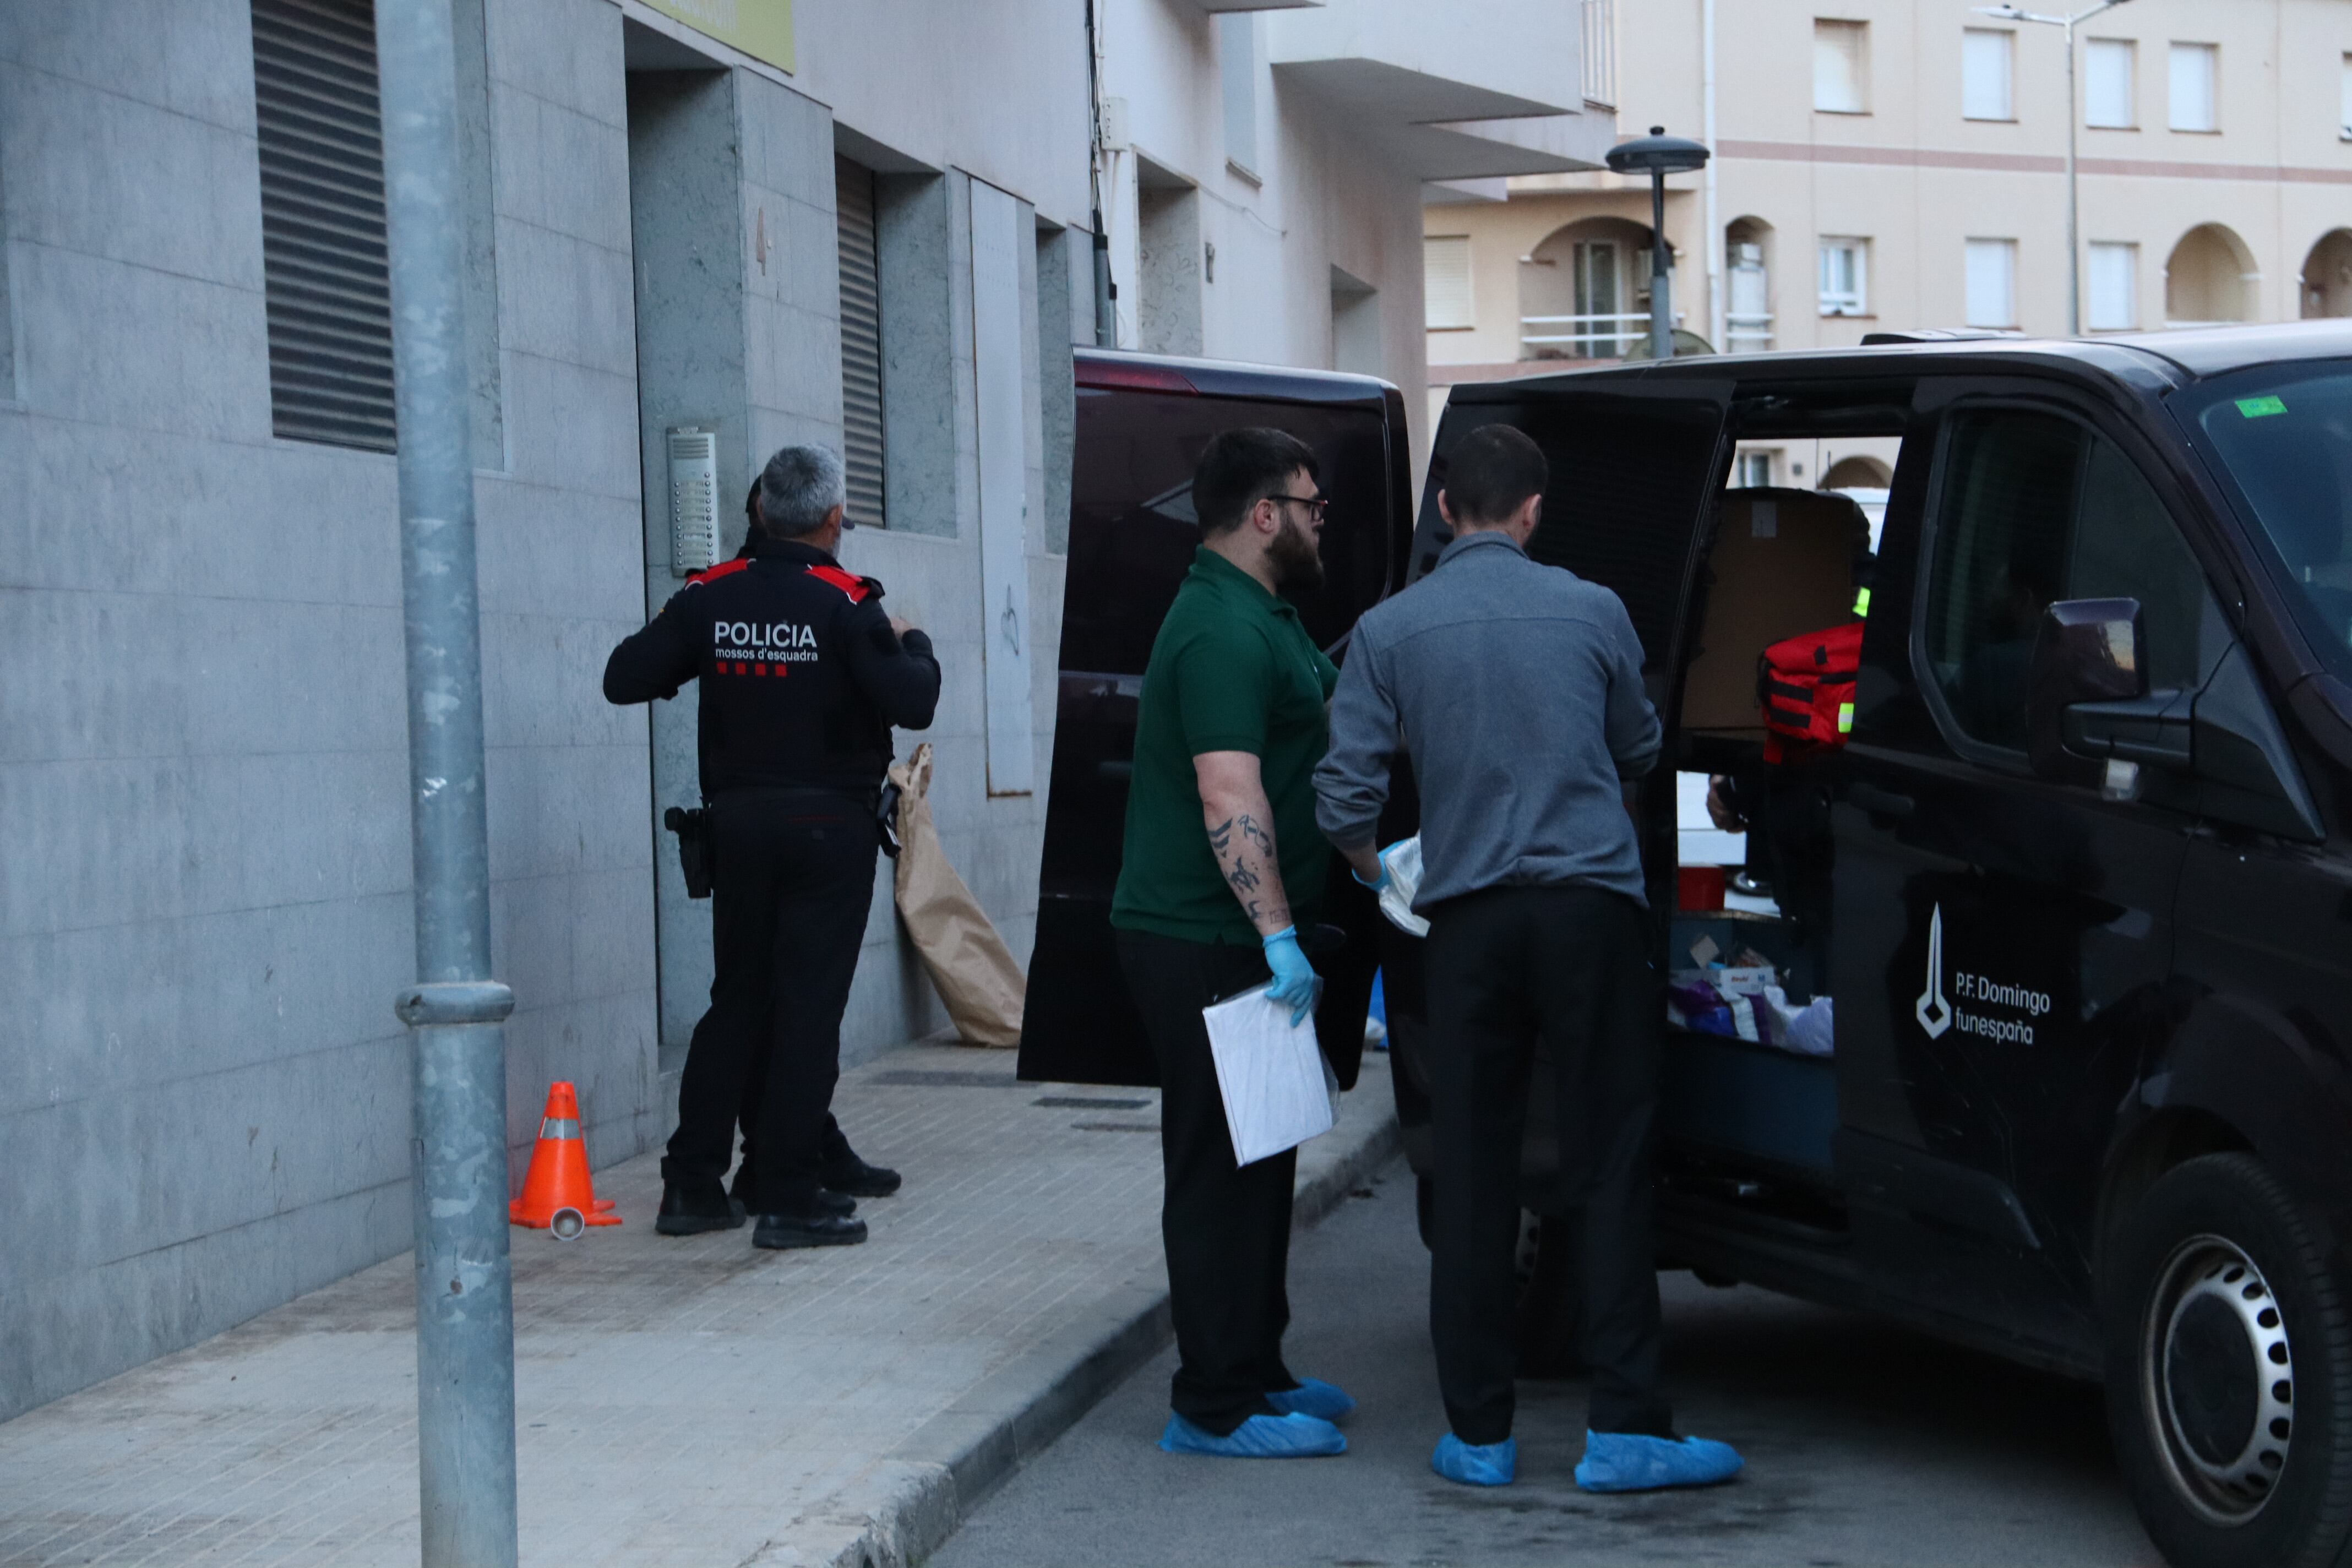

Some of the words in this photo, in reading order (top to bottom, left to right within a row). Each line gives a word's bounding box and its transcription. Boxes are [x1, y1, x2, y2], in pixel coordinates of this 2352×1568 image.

[715, 621, 817, 648] POLICIA
[716, 648, 755, 659] mossos
[758, 647, 818, 663] d'esquadra
[1956, 971, 1975, 998] P.F.
[1978, 976, 2050, 1016] Domingo
[1956, 1006, 2033, 1045] funespaña
